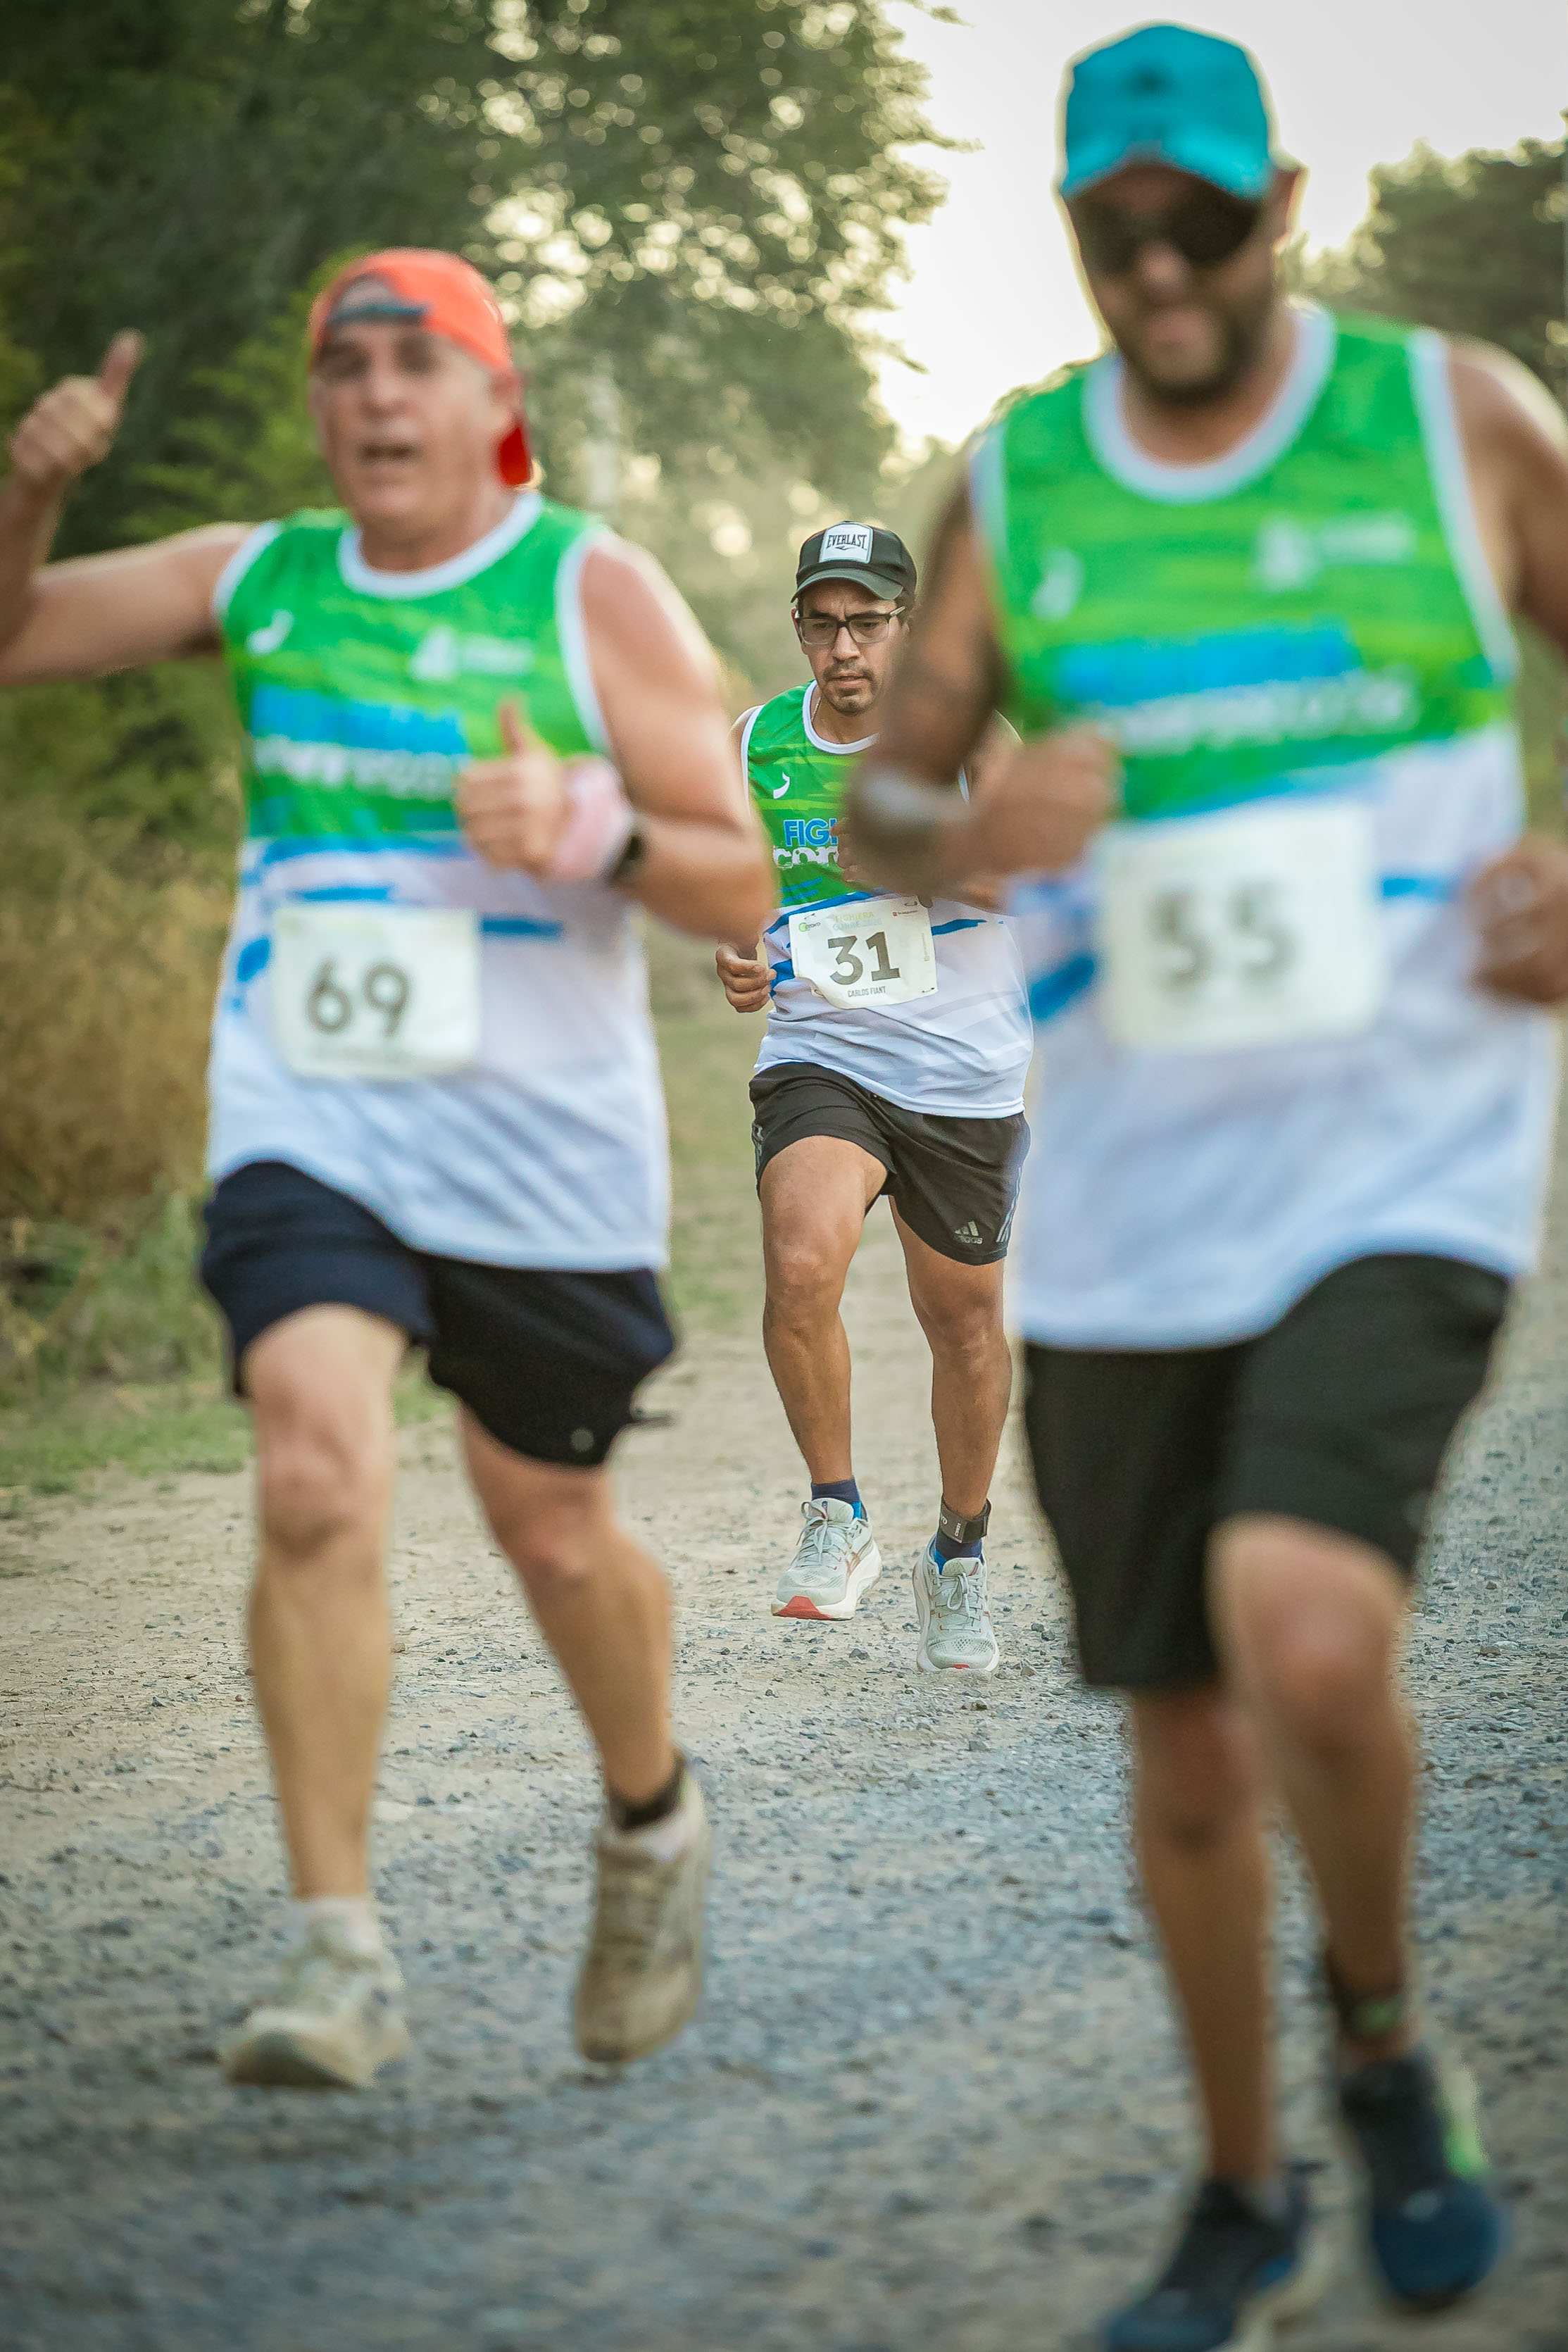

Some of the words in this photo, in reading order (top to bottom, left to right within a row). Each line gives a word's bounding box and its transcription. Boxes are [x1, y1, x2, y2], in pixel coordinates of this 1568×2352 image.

[826, 534, 867, 551] EVERLAST
[827, 931, 901, 985] 31
[1149, 884, 1301, 999] 55
[305, 955, 411, 1039] 69
[848, 988, 869, 997] CARLOS
[870, 986, 886, 994] FIANT
